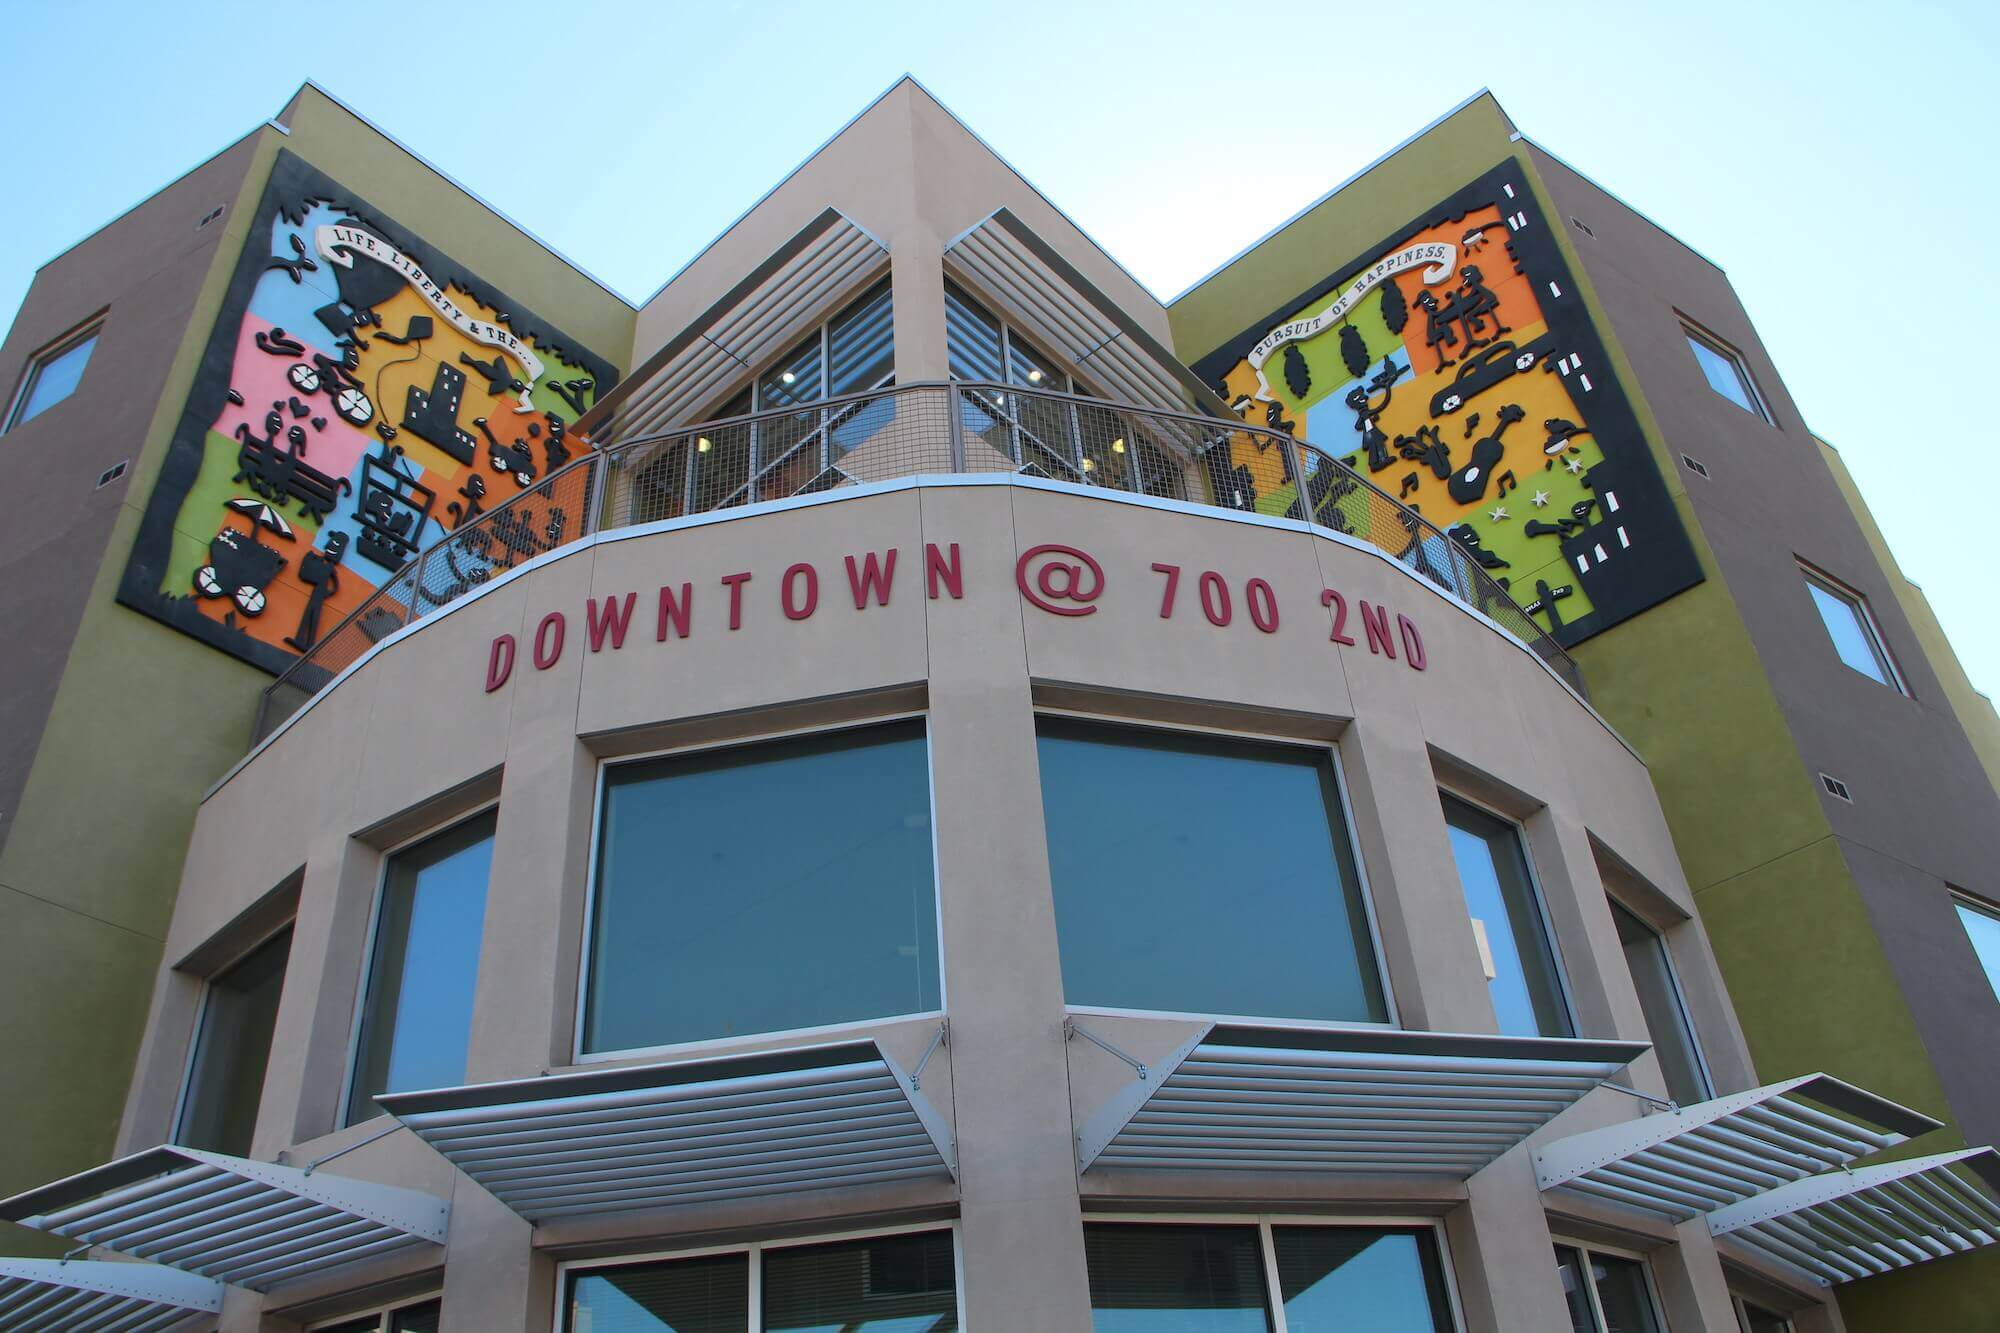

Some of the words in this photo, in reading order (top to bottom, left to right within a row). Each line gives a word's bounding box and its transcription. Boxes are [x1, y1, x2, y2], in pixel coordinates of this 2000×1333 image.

[391, 252, 463, 321] LIBERTY
[470, 322, 479, 334] &
[1255, 318, 1321, 357] PURSUIT
[1332, 297, 1350, 315] OF
[485, 543, 963, 693] DOWNTOWN
[1015, 543, 1105, 617] @
[1151, 562, 1279, 633] 700
[1320, 588, 1427, 671] 2ND
